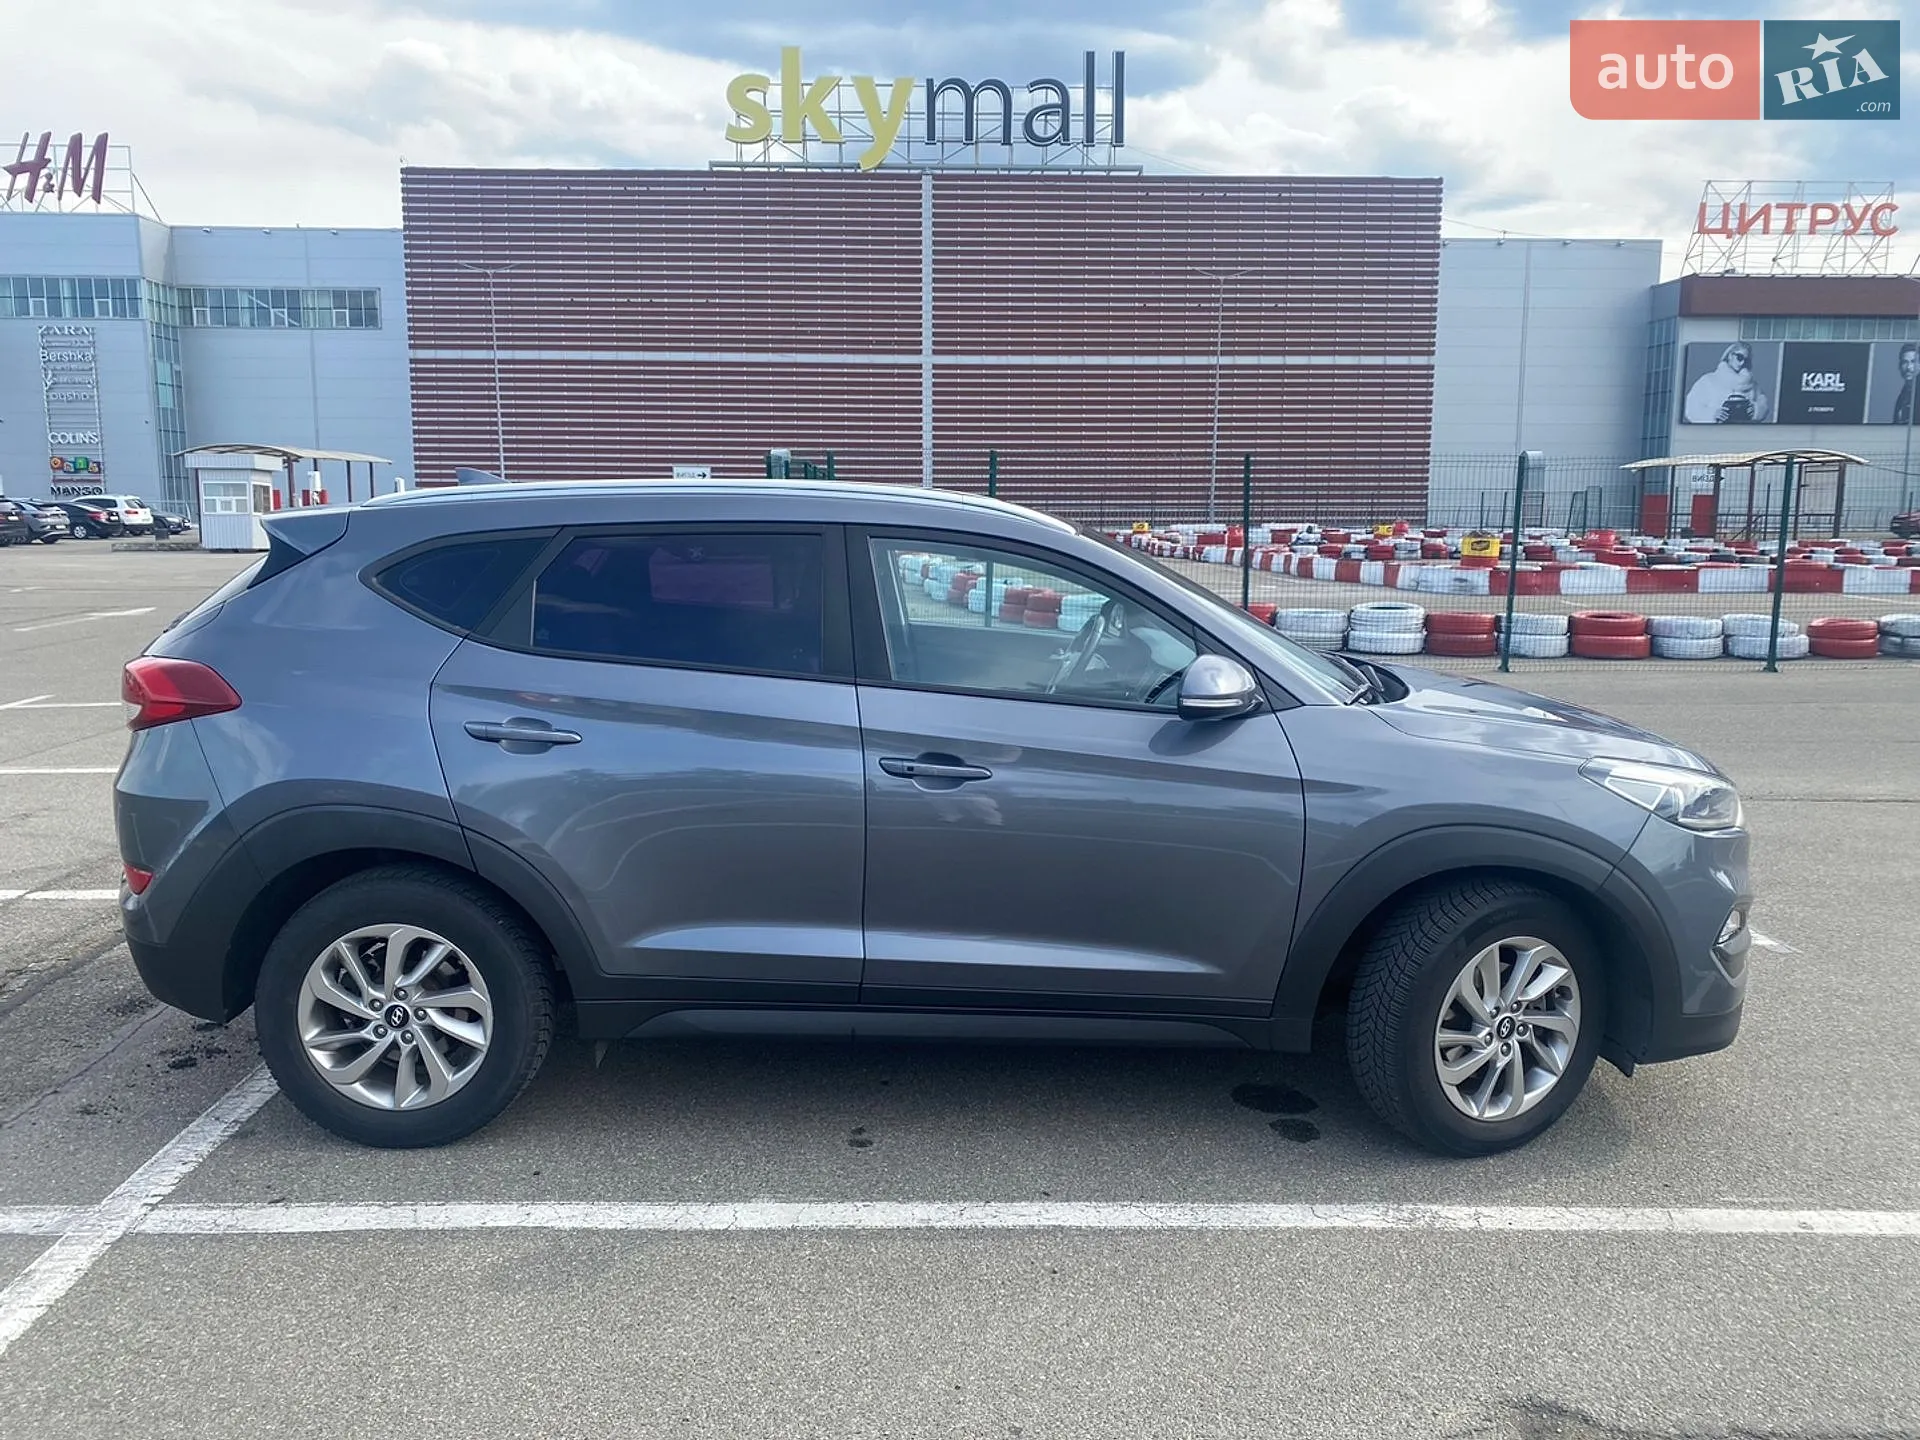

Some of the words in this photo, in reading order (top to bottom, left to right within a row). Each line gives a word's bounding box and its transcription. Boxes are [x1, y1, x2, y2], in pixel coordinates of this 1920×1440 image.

[2, 131, 109, 204] H&M
[1698, 203, 1899, 239] ЦИТРУС
[40, 350, 92, 361] Bershka
[1802, 372, 1845, 387] KARL
